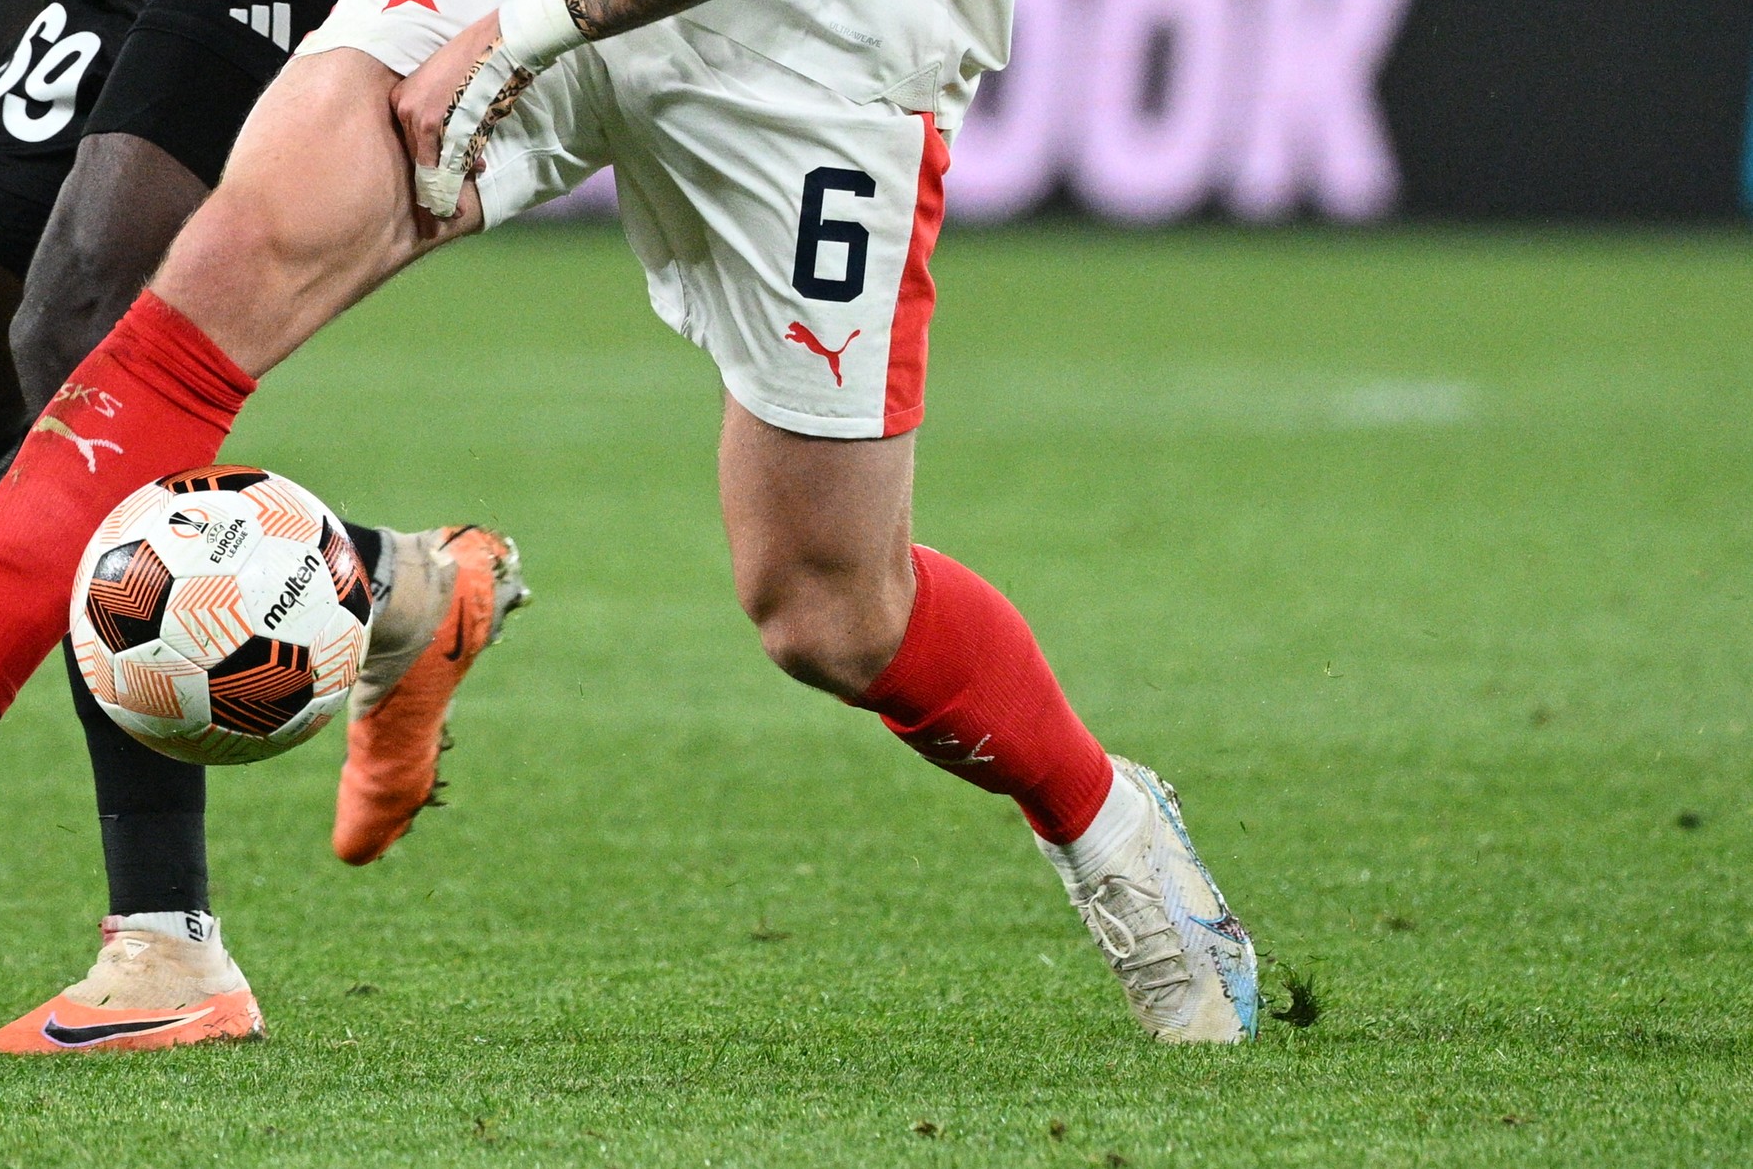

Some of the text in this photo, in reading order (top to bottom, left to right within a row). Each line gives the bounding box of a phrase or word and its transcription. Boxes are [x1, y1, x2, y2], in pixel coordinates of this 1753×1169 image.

[829, 21, 883, 48] ULTRAWEAVE
[792, 166, 876, 303] 6
[54, 383, 123, 418] SKS
[209, 524, 226, 544] UEFA
[209, 518, 247, 564] EUROPA
[227, 531, 248, 558] LEAGUE
[263, 554, 320, 631] molten
